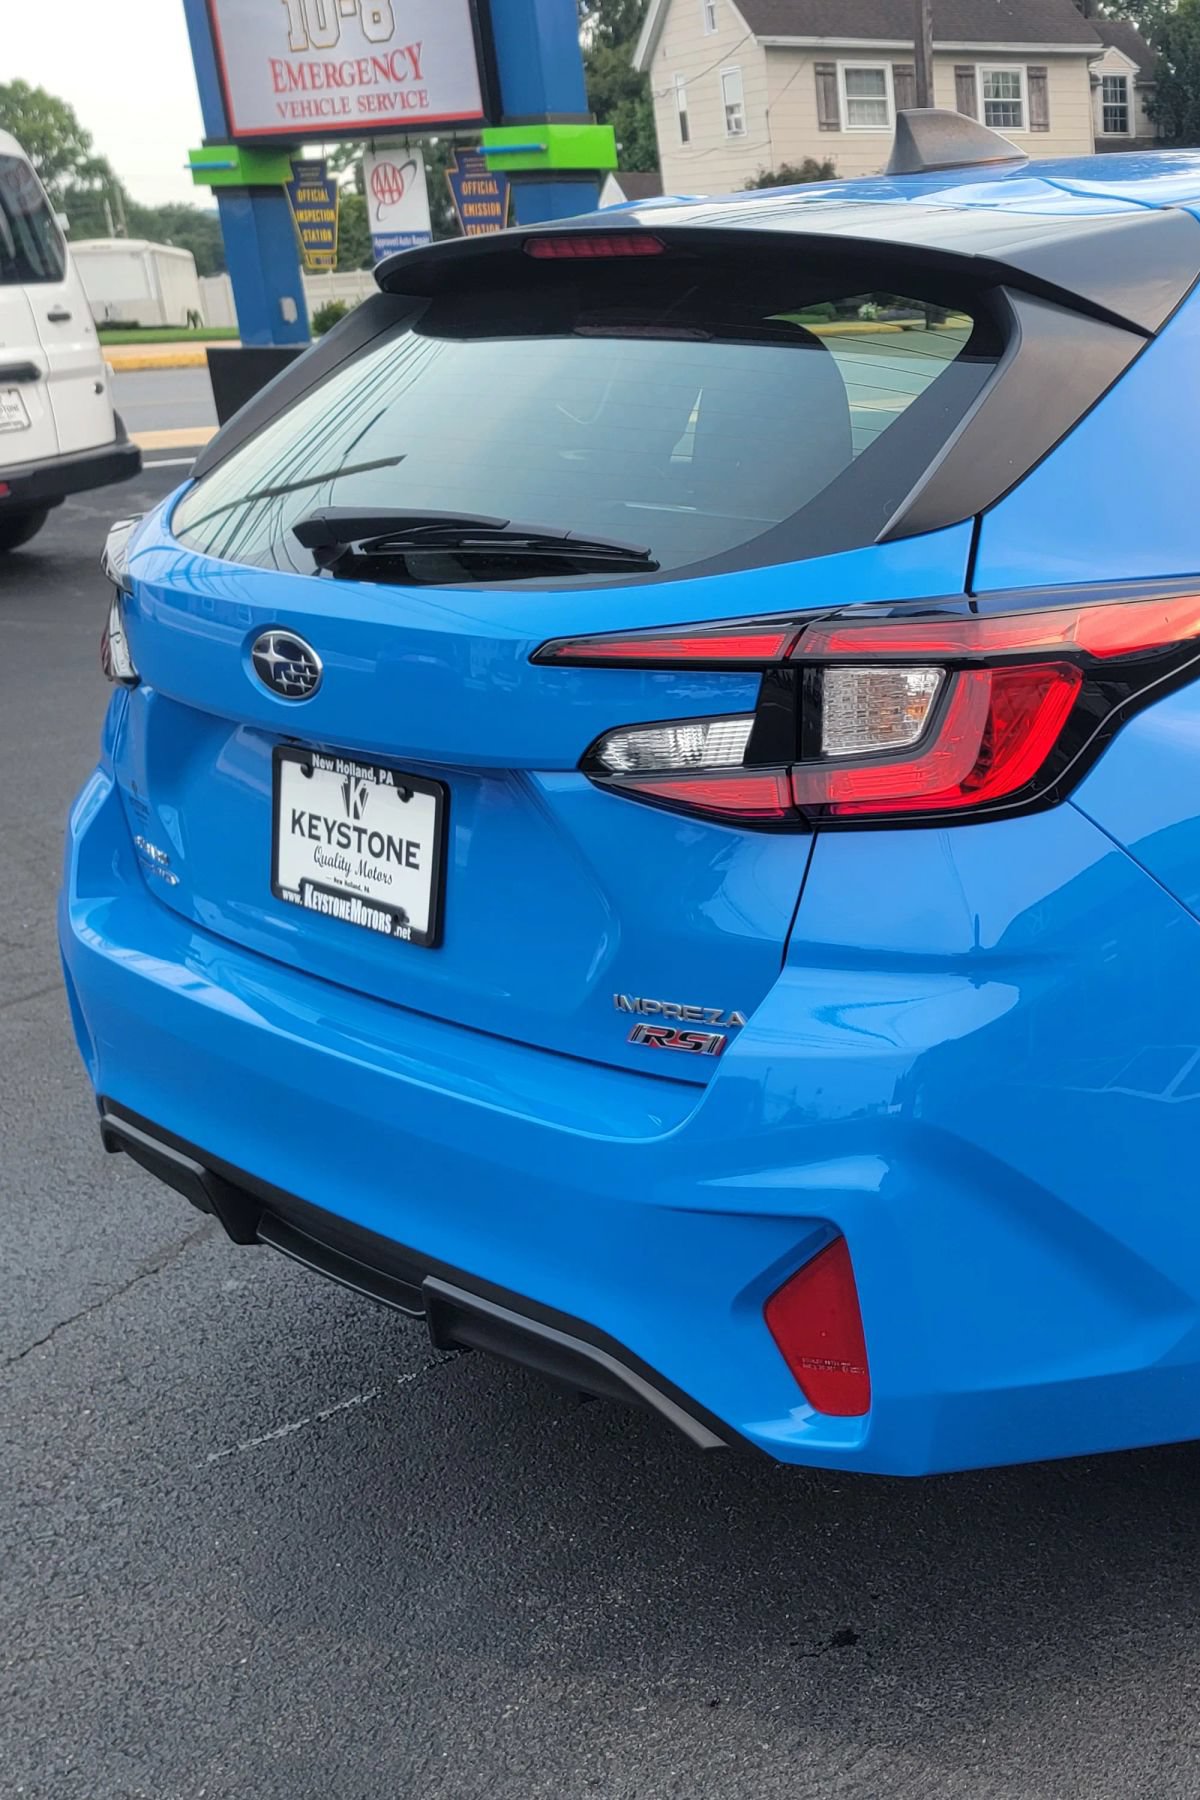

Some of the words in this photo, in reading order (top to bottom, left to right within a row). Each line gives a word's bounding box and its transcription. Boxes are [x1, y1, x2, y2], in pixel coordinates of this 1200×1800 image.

[270, 41, 424, 94] EMERGENCY
[276, 95, 351, 119] VEHICLE
[357, 89, 430, 113] SERVICE
[296, 187, 329, 203] OFFICIAL
[375, 163, 403, 204] AAA
[462, 180, 499, 195] OFFICIAL
[296, 208, 337, 222] INSPECTION
[463, 202, 501, 217] EMISSION
[302, 227, 332, 243] STATION
[312, 753, 334, 771] New
[336, 759, 377, 784] Holland,
[379, 769, 394, 786] PA
[291, 808, 421, 870] KEYSTONE
[313, 845, 351, 877] Quality
[355, 859, 393, 886] Motors
[613, 993, 749, 1028] IMPREZA
